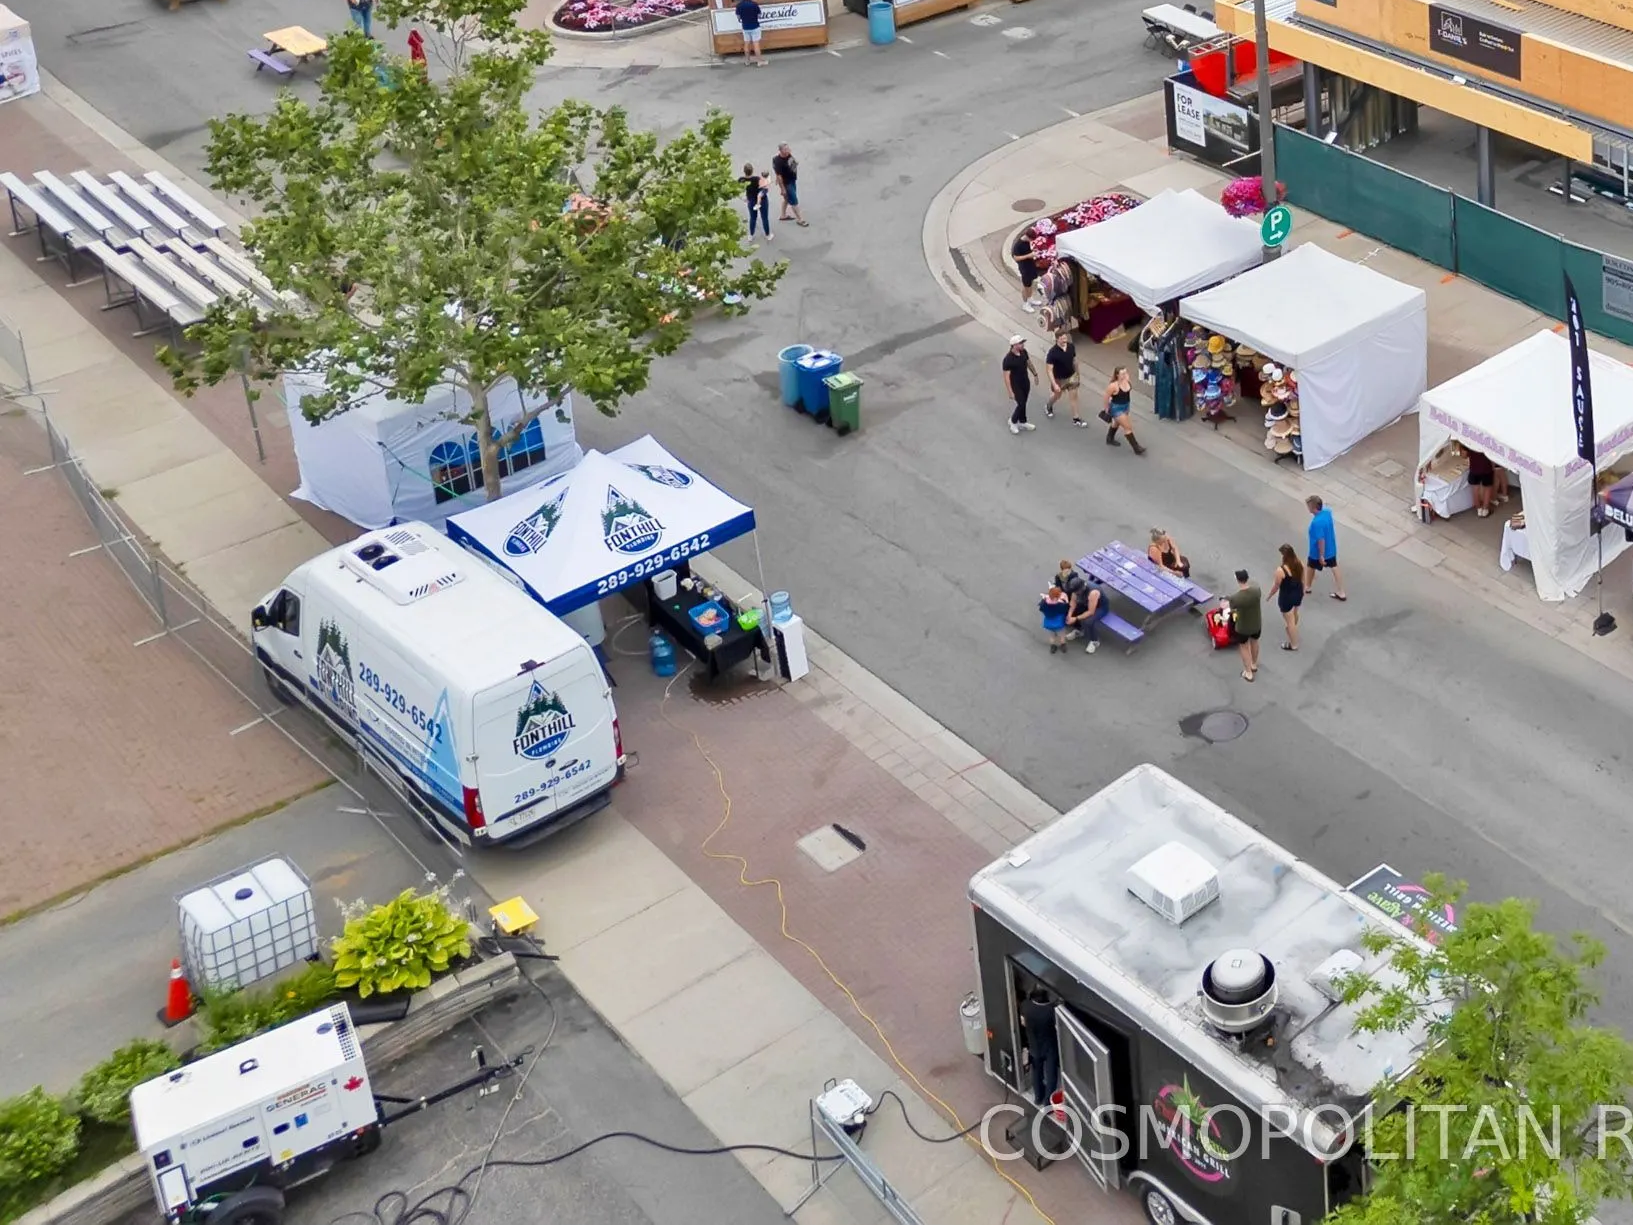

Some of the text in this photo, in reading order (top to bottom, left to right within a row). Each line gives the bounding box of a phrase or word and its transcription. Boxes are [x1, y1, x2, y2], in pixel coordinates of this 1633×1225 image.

[759, 5, 798, 20] uceside
[1177, 93, 1193, 106] FOR
[1177, 105, 1200, 121] LEASE
[1271, 210, 1283, 232] P
[510, 521, 548, 554] FONTHILL
[603, 518, 667, 552] FONTHILL
[597, 533, 711, 595] 289-929-6542
[359, 662, 443, 744] 289-929-6542
[512, 714, 576, 755] FONTHILL
[514, 759, 592, 804] 289-929-6542
[1384, 883, 1412, 904] GRILL
[266, 1082, 327, 1113] GENERAC
[1203, 1152, 1231, 1179] GRILL
